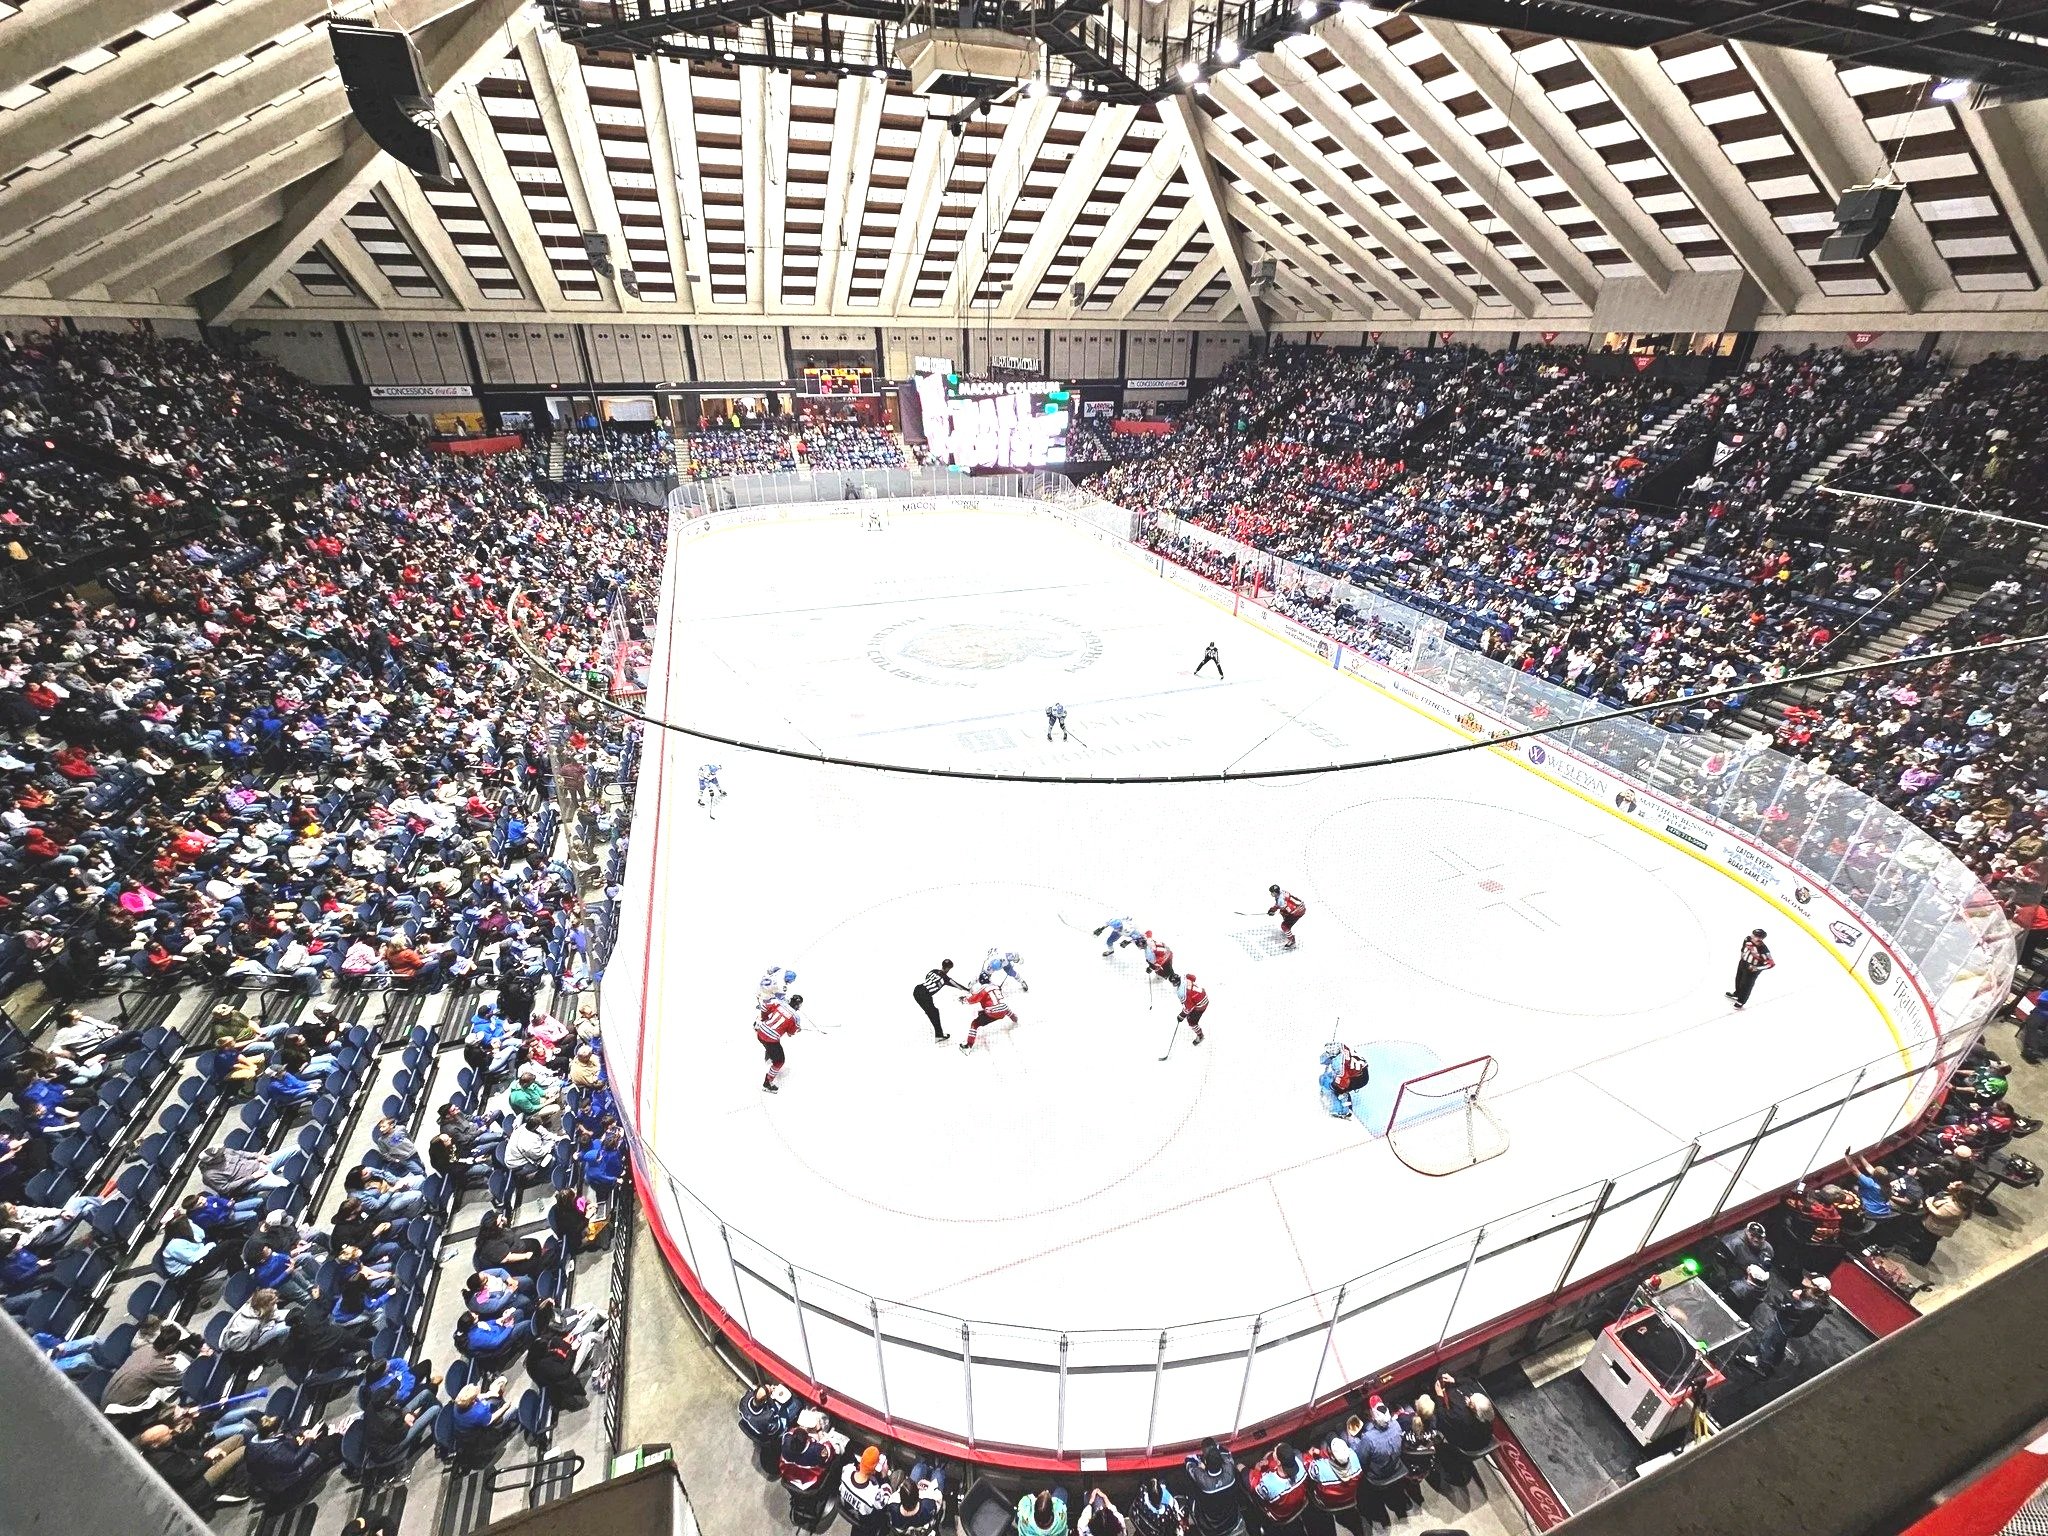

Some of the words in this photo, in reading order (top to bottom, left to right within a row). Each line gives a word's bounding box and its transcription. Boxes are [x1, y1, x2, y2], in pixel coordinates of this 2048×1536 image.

[386, 387, 433, 396] CONCESSIONS
[958, 382, 1003, 395] MACON
[1005, 381, 1060, 394] COLISEUM
[1547, 754, 1608, 794] WESLEYAN
[1722, 846, 1781, 886] MAYHEM
[1727, 857, 1744, 872] ROAD
[1743, 867, 1760, 882] GAME
[1759, 877, 1769, 887] AT
[1735, 845, 1755, 861] CATCH
[1755, 856, 1774, 872] EVERY
[843, 1489, 862, 1511] HOWE
